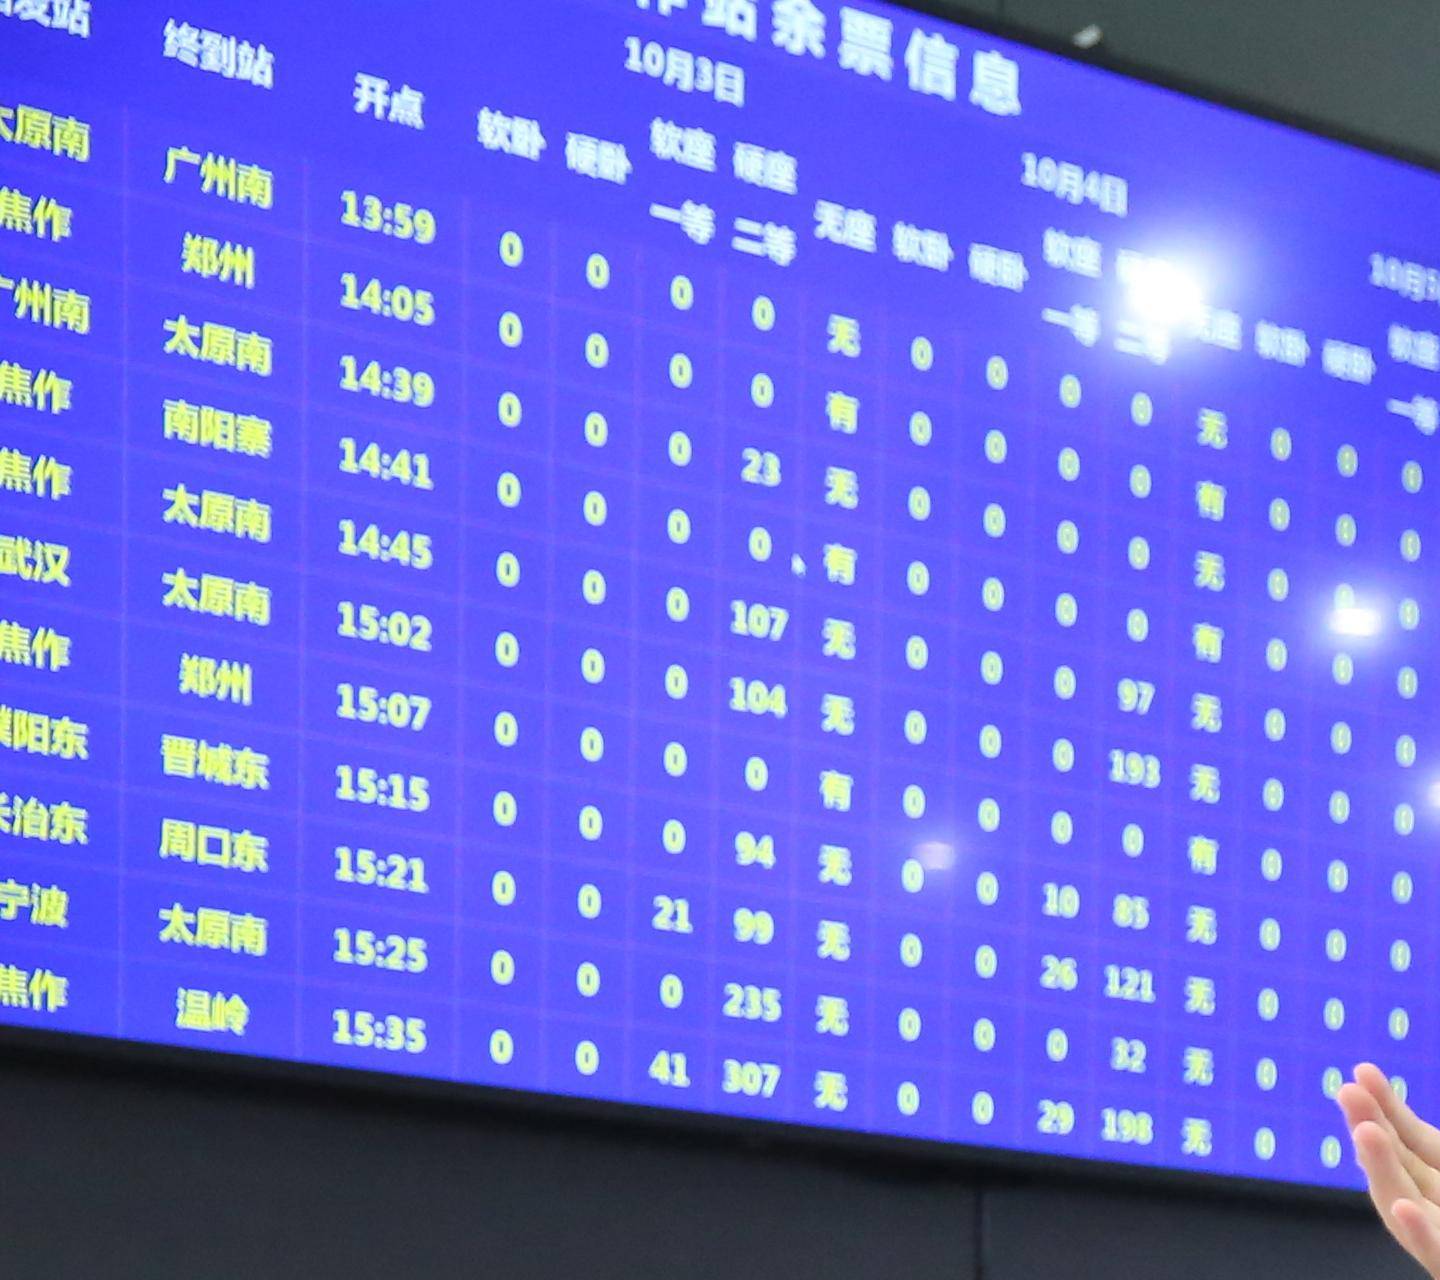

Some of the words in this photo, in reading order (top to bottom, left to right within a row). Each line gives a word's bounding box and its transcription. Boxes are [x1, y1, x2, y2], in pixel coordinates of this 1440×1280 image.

[0, 0, 91, 38] 发站
[163, 18, 274, 89] 终到站
[353, 73, 424, 129] 开点
[477, 107, 546, 161] 软卧
[650, 117, 716, 171] 软座
[814, 199, 877, 253] 无座
[625, 37, 744, 107] 10月3日
[636, 0, 1021, 116] 站余票信息
[164, 146, 273, 209] 广州南
[341, 191, 436, 244] 13:59
[500, 231, 523, 267] 0
[586, 254, 610, 288] 0
[670, 275, 693, 310] 0
[752, 296, 775, 330] 0
[827, 314, 861, 357] 无
[650, 200, 715, 244] 一等
[732, 218, 796, 266] 二等
[1021, 152, 1128, 218] 10月4日
[0, 275, 90, 334] 州南
[163, 315, 272, 376] 太原南
[340, 356, 434, 407] 14:39
[498, 392, 522, 427] 0
[585, 412, 608, 447] 0
[669, 431, 691, 466] 0
[741, 448, 781, 486] 23
[825, 467, 858, 509] 无
[182, 232, 254, 289] 郑州
[341, 273, 435, 325] 14:05
[499, 312, 522, 347] 0
[585, 333, 609, 368] 0
[669, 353, 692, 388] 0
[751, 373, 774, 407] 0
[826, 391, 859, 434] 有
[163, 399, 272, 458] 南阳寨
[339, 438, 433, 489] 14:41
[497, 472, 521, 507] 0
[583, 491, 607, 525] 0
[668, 509, 690, 544] 0
[749, 527, 772, 561] 0
[823, 544, 857, 585] 有
[163, 484, 271, 542] 太原南
[339, 519, 433, 569] 14:45
[496, 552, 520, 587] 0
[583, 570, 606, 604] 0
[666, 587, 689, 621] 0
[731, 600, 789, 641] 107
[823, 618, 856, 659] 无
[162, 568, 271, 626] 太原南
[338, 602, 432, 651] 15:02
[495, 632, 519, 667] 0
[581, 649, 605, 683] 0
[665, 665, 688, 699] 0
[730, 677, 788, 717] 104
[821, 694, 855, 735] 无
[179, 653, 252, 705] 郑州
[337, 683, 431, 730] 15:07
[494, 712, 518, 746] 0
[580, 727, 604, 761] 0
[664, 742, 687, 776] 0
[745, 757, 768, 790] 0
[820, 770, 853, 811] 有
[160, 734, 269, 789] 晋城东
[336, 765, 429, 812] 15:15
[493, 791, 517, 826] 0
[579, 806, 602, 840] 0
[663, 820, 686, 854] 0
[735, 832, 776, 869] 94
[819, 845, 852, 885] 无
[159, 818, 269, 872] 周口东
[335, 847, 429, 893] 15:21
[492, 871, 516, 905] 0
[578, 884, 601, 918] 0
[652, 895, 693, 933] 21
[817, 920, 850, 960] 无
[159, 903, 268, 956] 太原南
[334, 928, 428, 972] 15:25
[491, 950, 514, 985] 0
[577, 962, 600, 997] 0
[660, 974, 683, 1008] 0
[816, 996, 849, 1036] 无
[176, 987, 250, 1035] 温岭
[333, 1009, 427, 1053] 15:35
[490, 1030, 513, 1064] 0
[575, 1041, 599, 1075] 0
[648, 1051, 690, 1087] 41
[814, 1071, 848, 1111] 无
